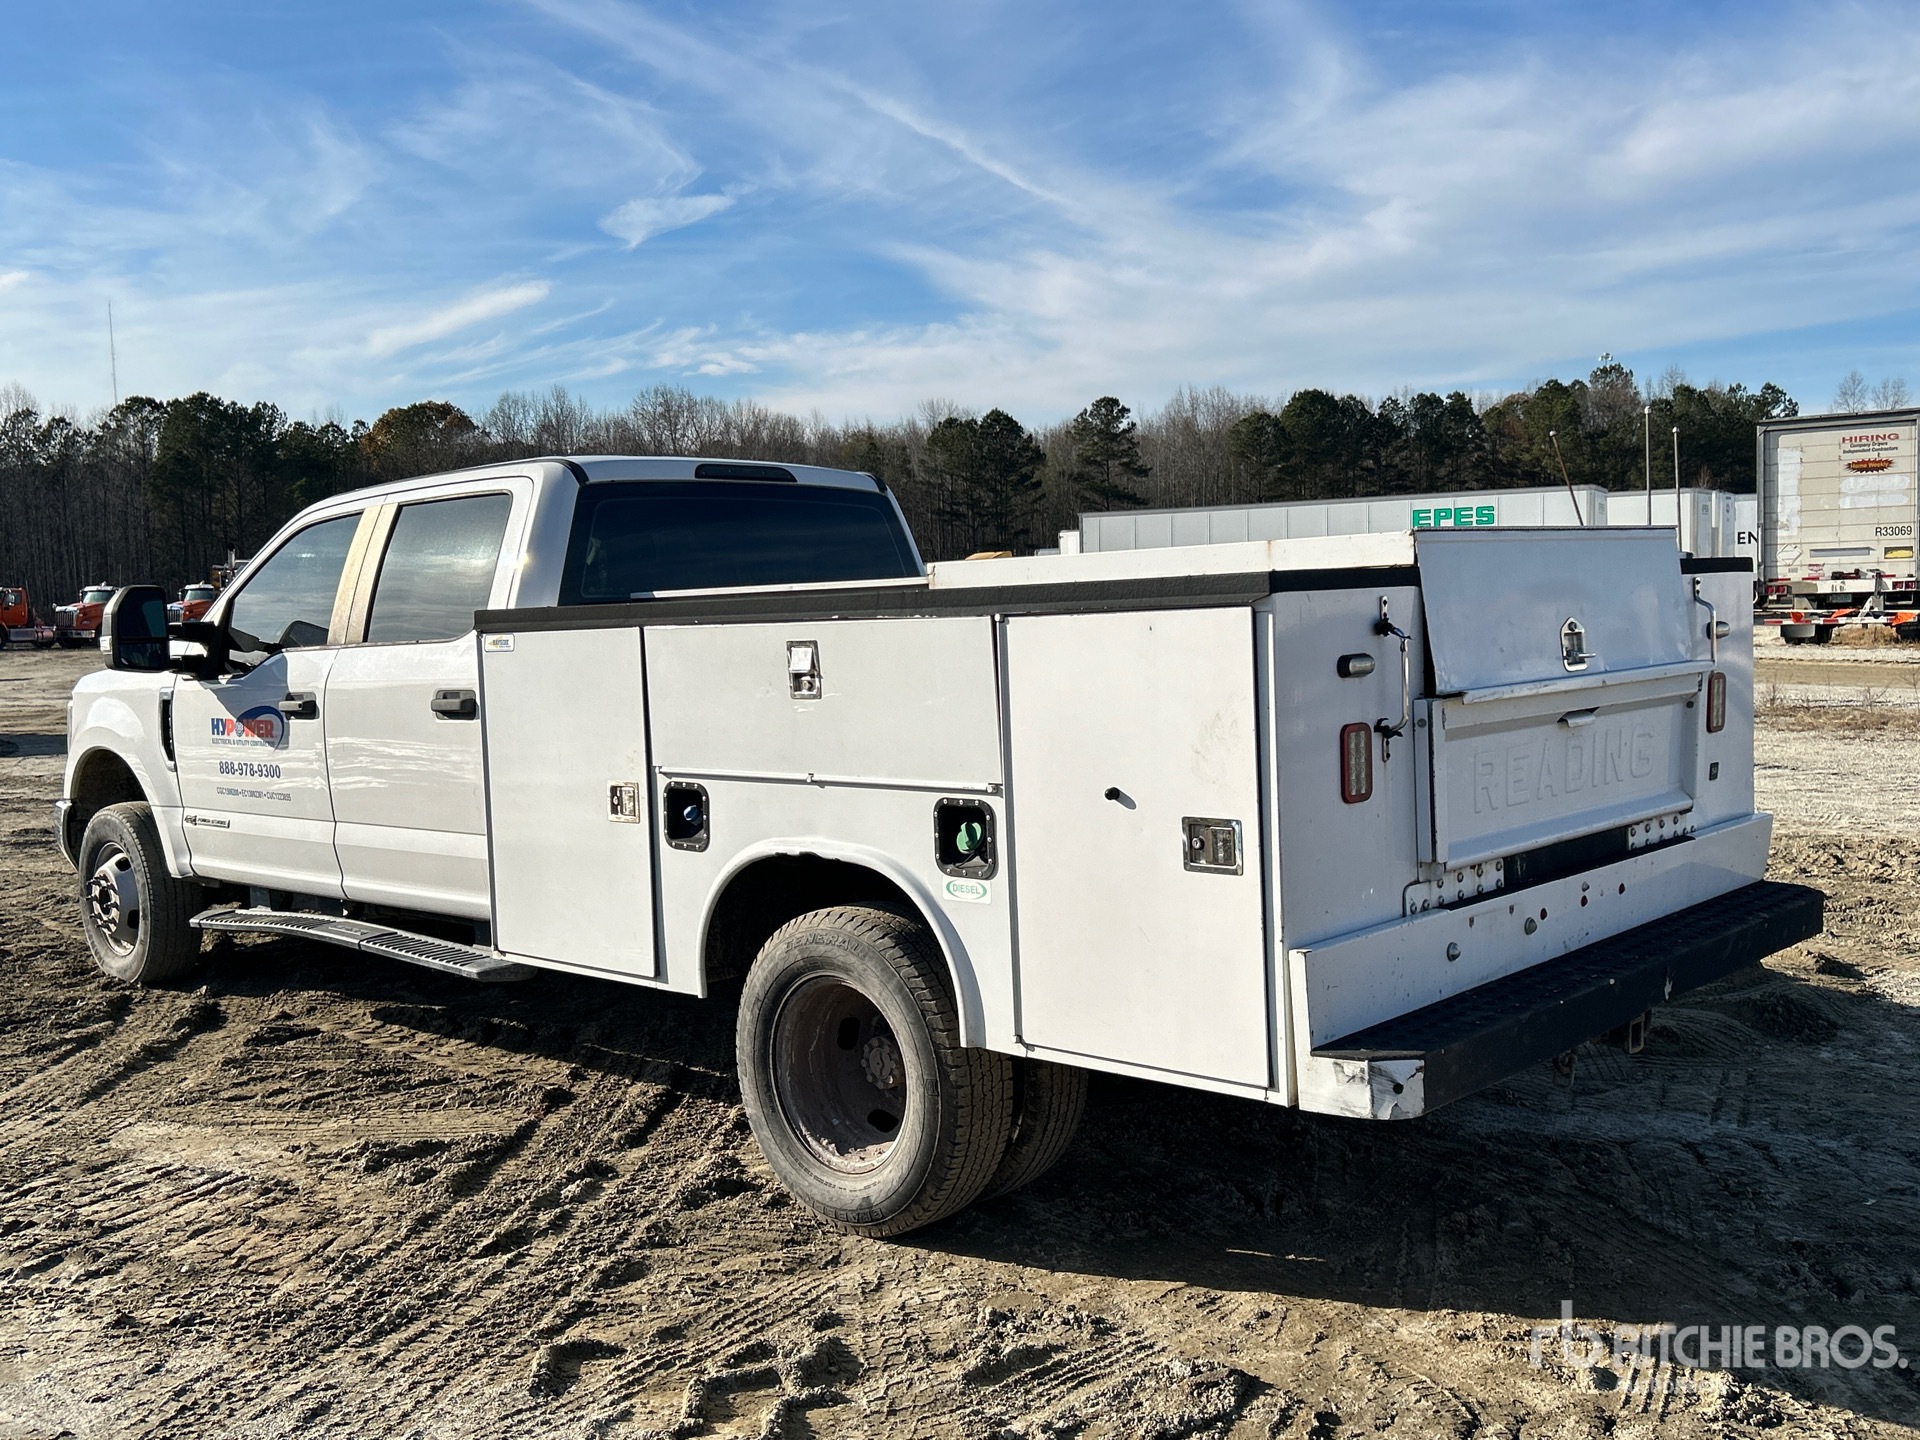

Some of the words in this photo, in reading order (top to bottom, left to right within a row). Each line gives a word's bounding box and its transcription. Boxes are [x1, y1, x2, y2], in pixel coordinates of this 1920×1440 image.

[1842, 433, 1899, 443] HIRING
[1413, 506, 1495, 527] EPES
[1875, 526, 1912, 536] R33069
[219, 761, 281, 779] 888-978-9300
[1474, 727, 1655, 814] READING
[952, 884, 981, 894] DIESEL
[785, 932, 861, 956] GENERAL
